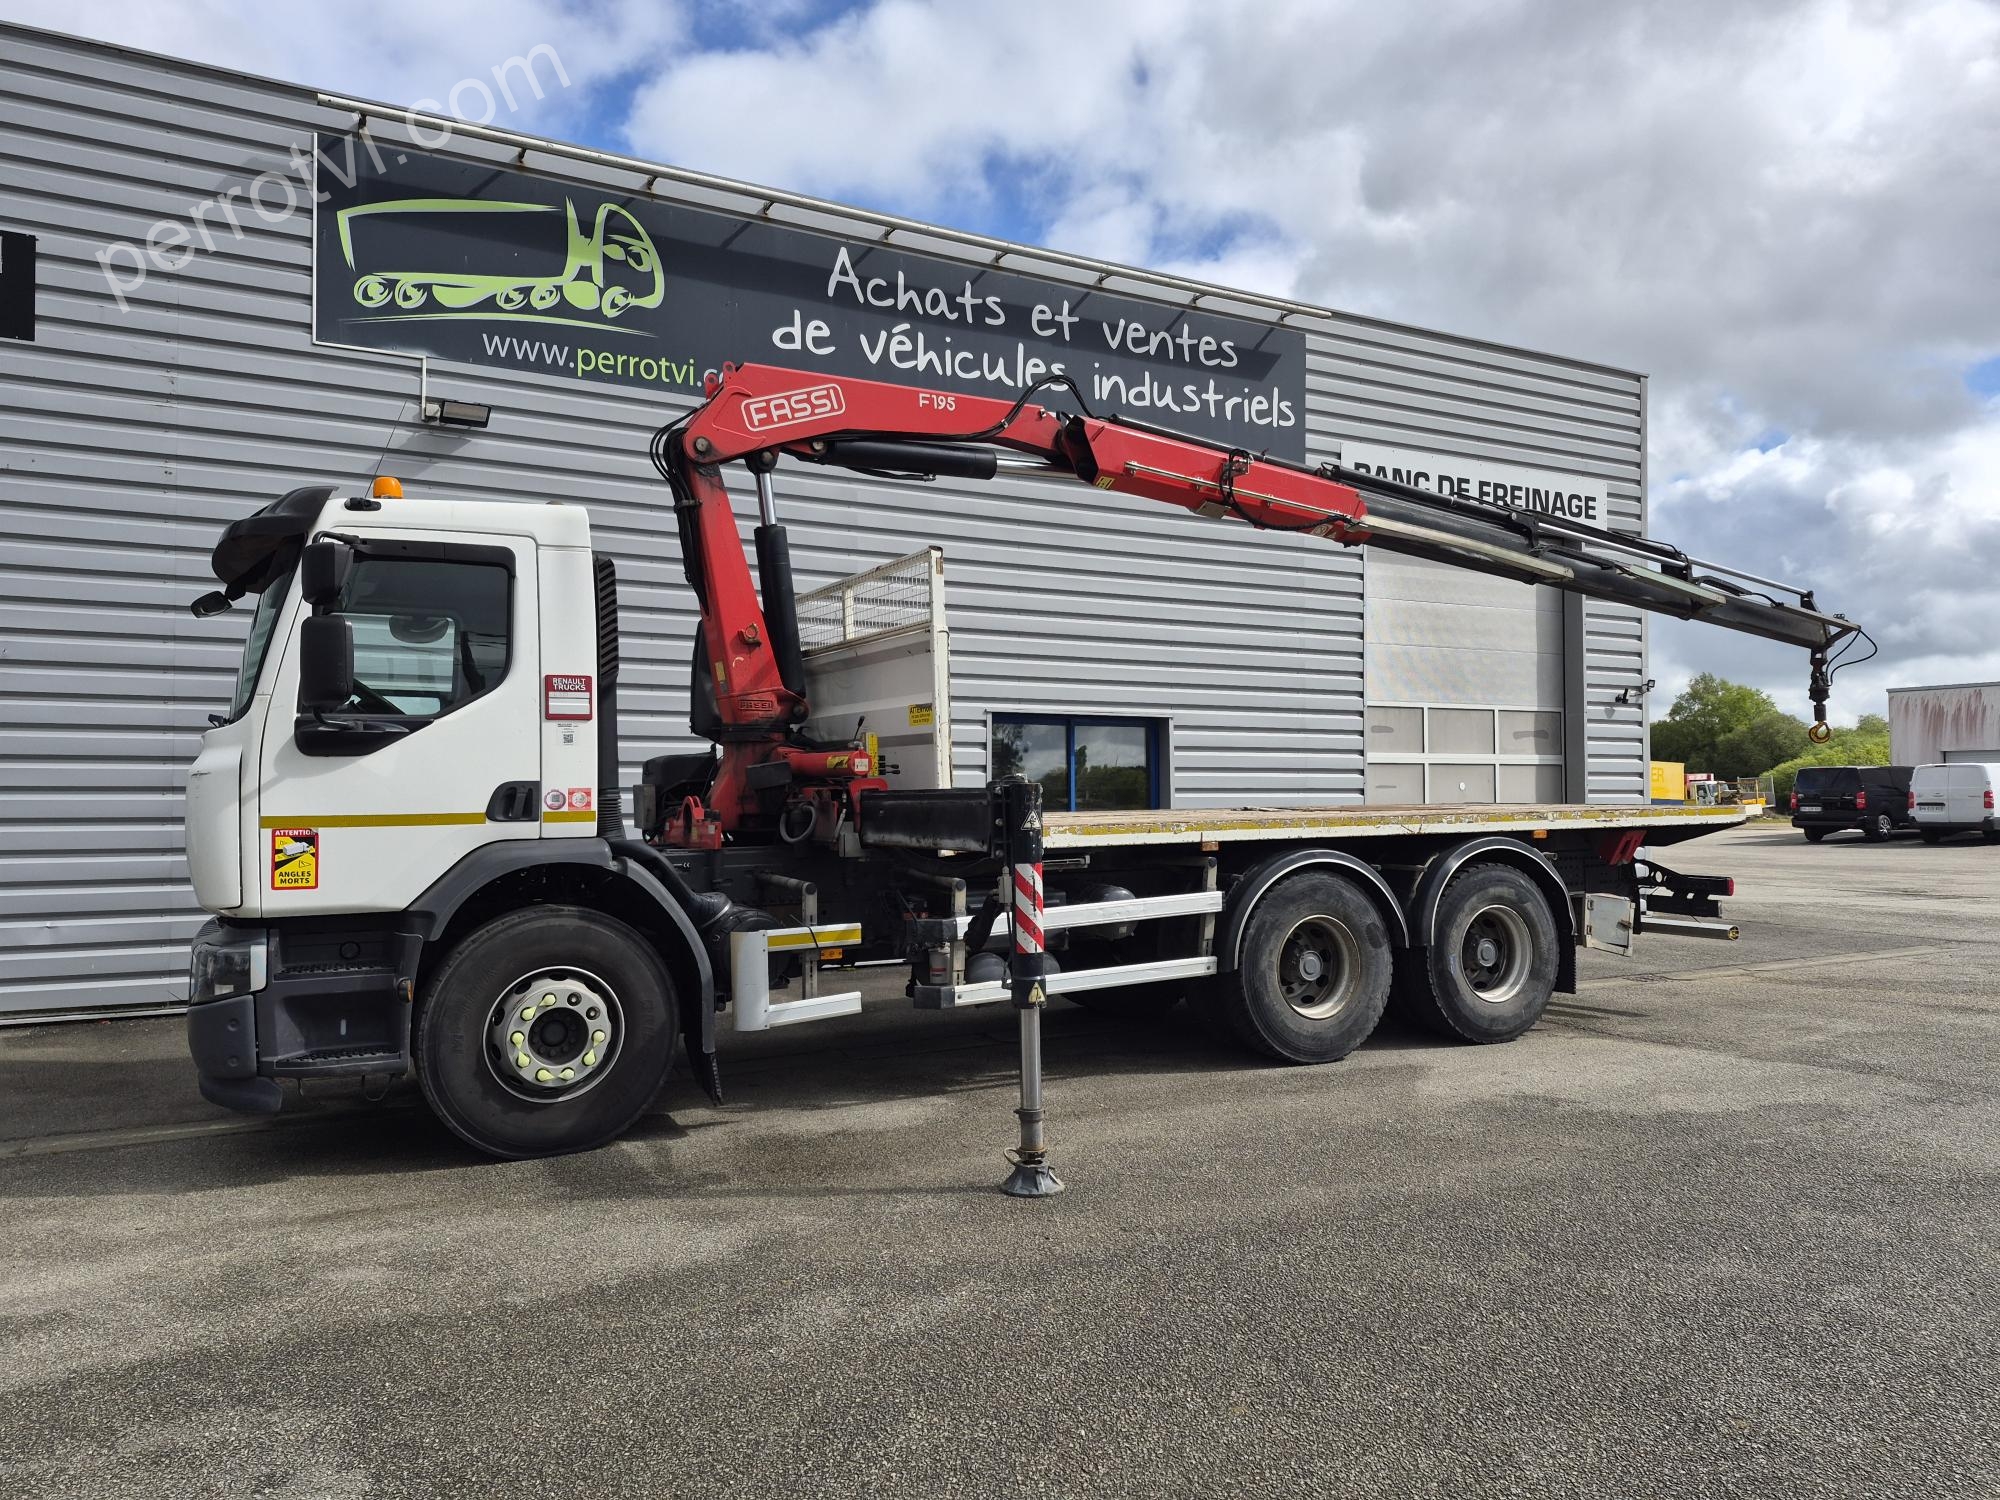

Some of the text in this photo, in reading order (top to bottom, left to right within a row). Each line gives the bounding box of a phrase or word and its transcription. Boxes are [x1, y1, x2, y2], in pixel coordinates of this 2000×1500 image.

[827, 246, 1238, 368] Achats et ventes
[482, 333, 724, 388] www.perrotvi.c
[772, 309, 1296, 428] de véhicules industriels
[749, 388, 839, 426] FASSI
[919, 393, 955, 411] F195
[1438, 474, 1470, 501] DE
[1479, 480, 1597, 520] FREINAGE
